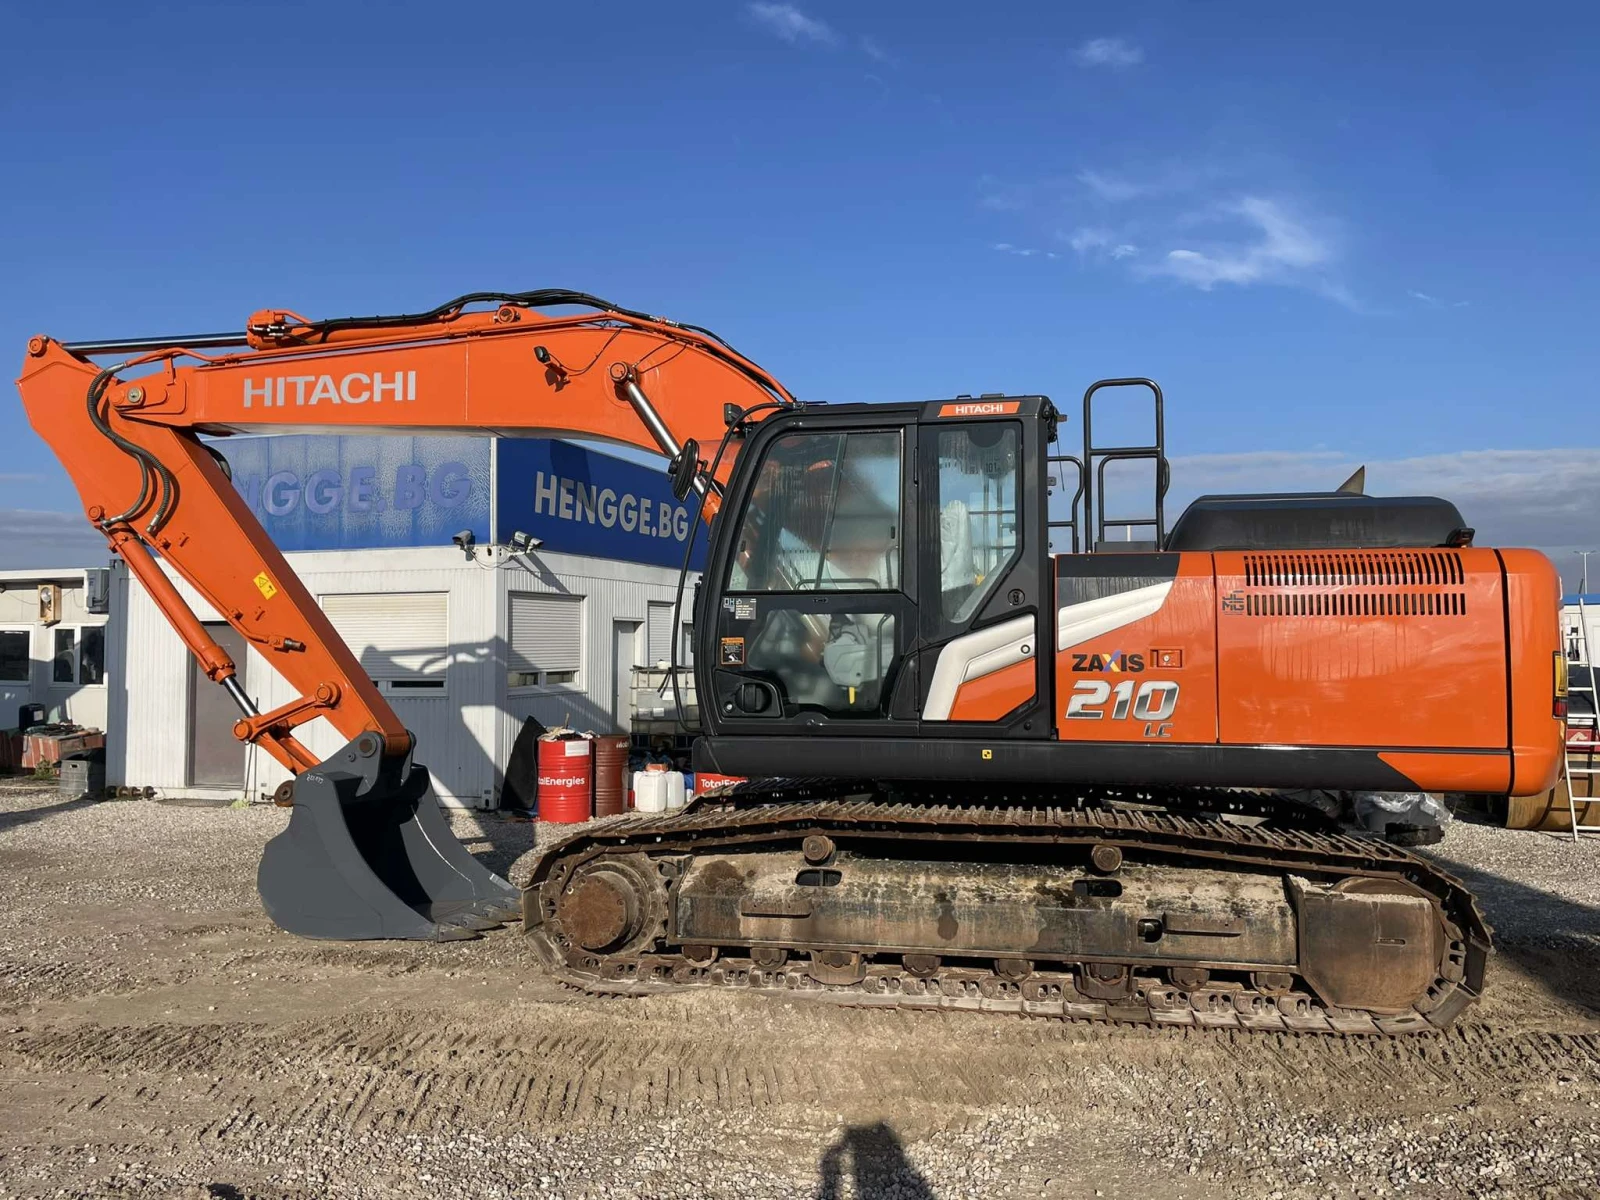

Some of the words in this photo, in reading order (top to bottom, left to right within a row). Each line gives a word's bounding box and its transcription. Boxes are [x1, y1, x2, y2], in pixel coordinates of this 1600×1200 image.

[243, 370, 416, 408] HITACHI
[955, 404, 1003, 415] HITACHI
[534, 470, 689, 542] HENGGE.BG
[1071, 649, 1145, 673] ZAXIS
[1065, 679, 1180, 721] 210
[1143, 722, 1173, 738] LC
